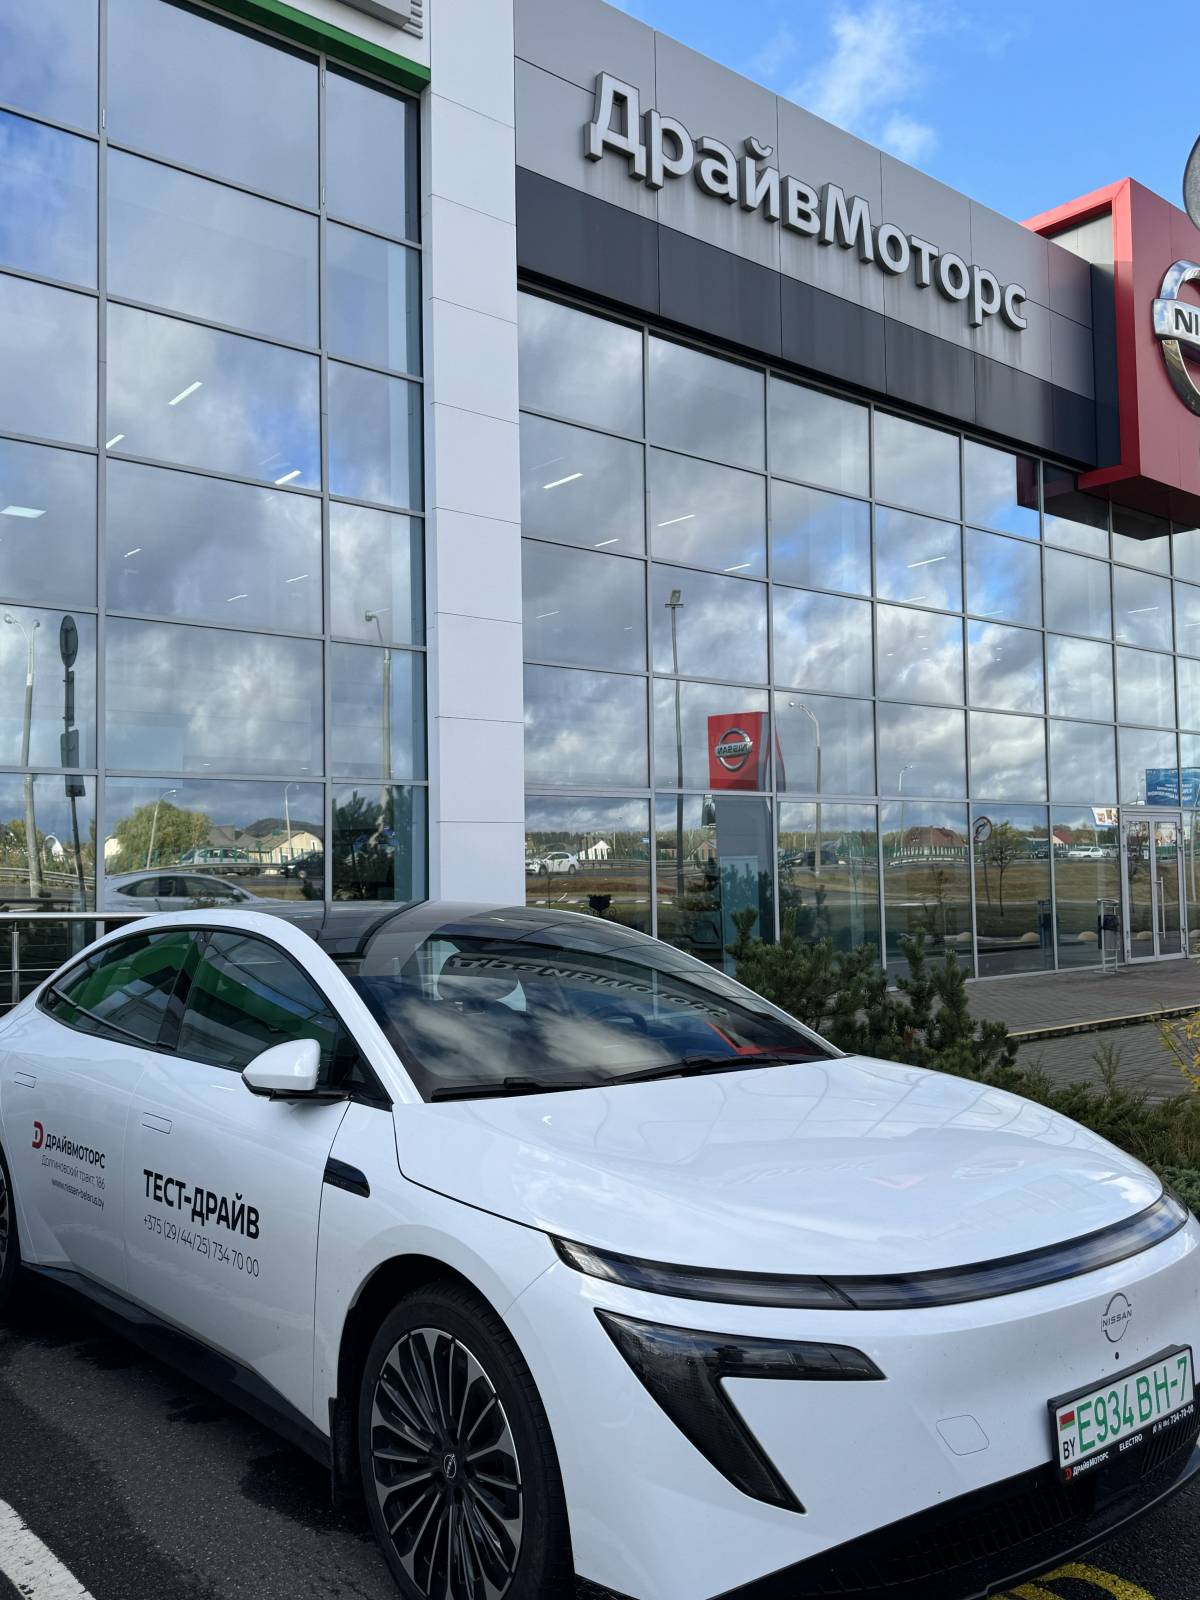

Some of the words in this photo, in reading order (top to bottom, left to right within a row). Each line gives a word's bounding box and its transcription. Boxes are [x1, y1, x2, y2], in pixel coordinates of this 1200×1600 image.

[584, 71, 1027, 331] ДрайвМоторс
[45, 1133, 105, 1169] ДРАЙВМОТОРС
[143, 1169, 260, 1240] ТЕСТ-ДРАЙВ
[144, 1214, 162, 1234] +375
[212, 1241, 230, 1265] 734
[231, 1249, 244, 1270] 70
[246, 1256, 259, 1277] 00
[1102, 1309, 1132, 1328] NISSAN
[1063, 1436, 1075, 1460] BY
[1119, 1433, 1143, 1451] ELECTRO
